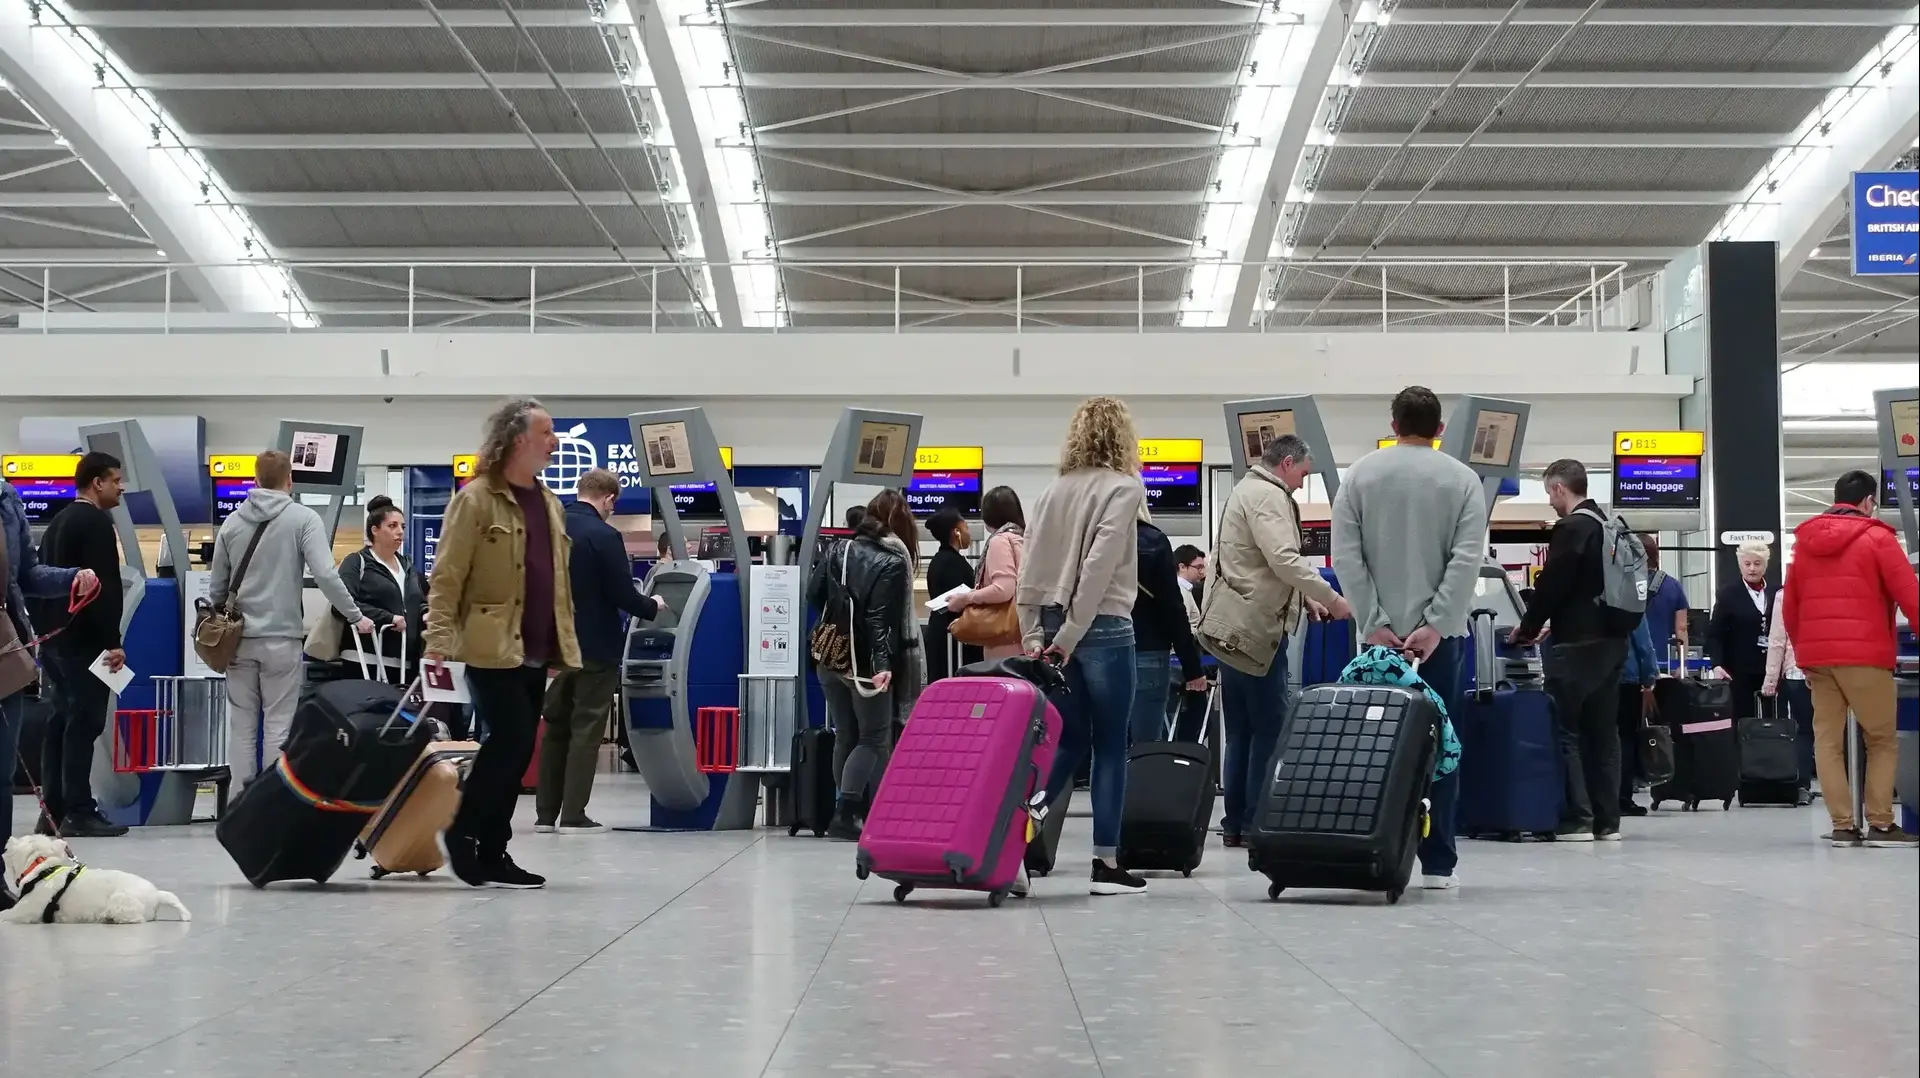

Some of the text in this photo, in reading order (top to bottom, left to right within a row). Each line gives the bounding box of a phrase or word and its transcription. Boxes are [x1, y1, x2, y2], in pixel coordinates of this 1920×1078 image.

[1867, 223, 1904, 233] BRITISH
[1868, 254, 1904, 262] IBERIA
[1636, 439, 1657, 449] B15
[919, 454, 939, 463] B12
[20, 462, 34, 471] B8
[228, 462, 241, 471] B9
[618, 475, 642, 488] OM
[1620, 482, 1684, 492] Hand baggage
[674, 494, 695, 504] drop
[907, 494, 945, 504] Bag drop
[28, 500, 48, 510] drop
[217, 501, 233, 510] Bag
